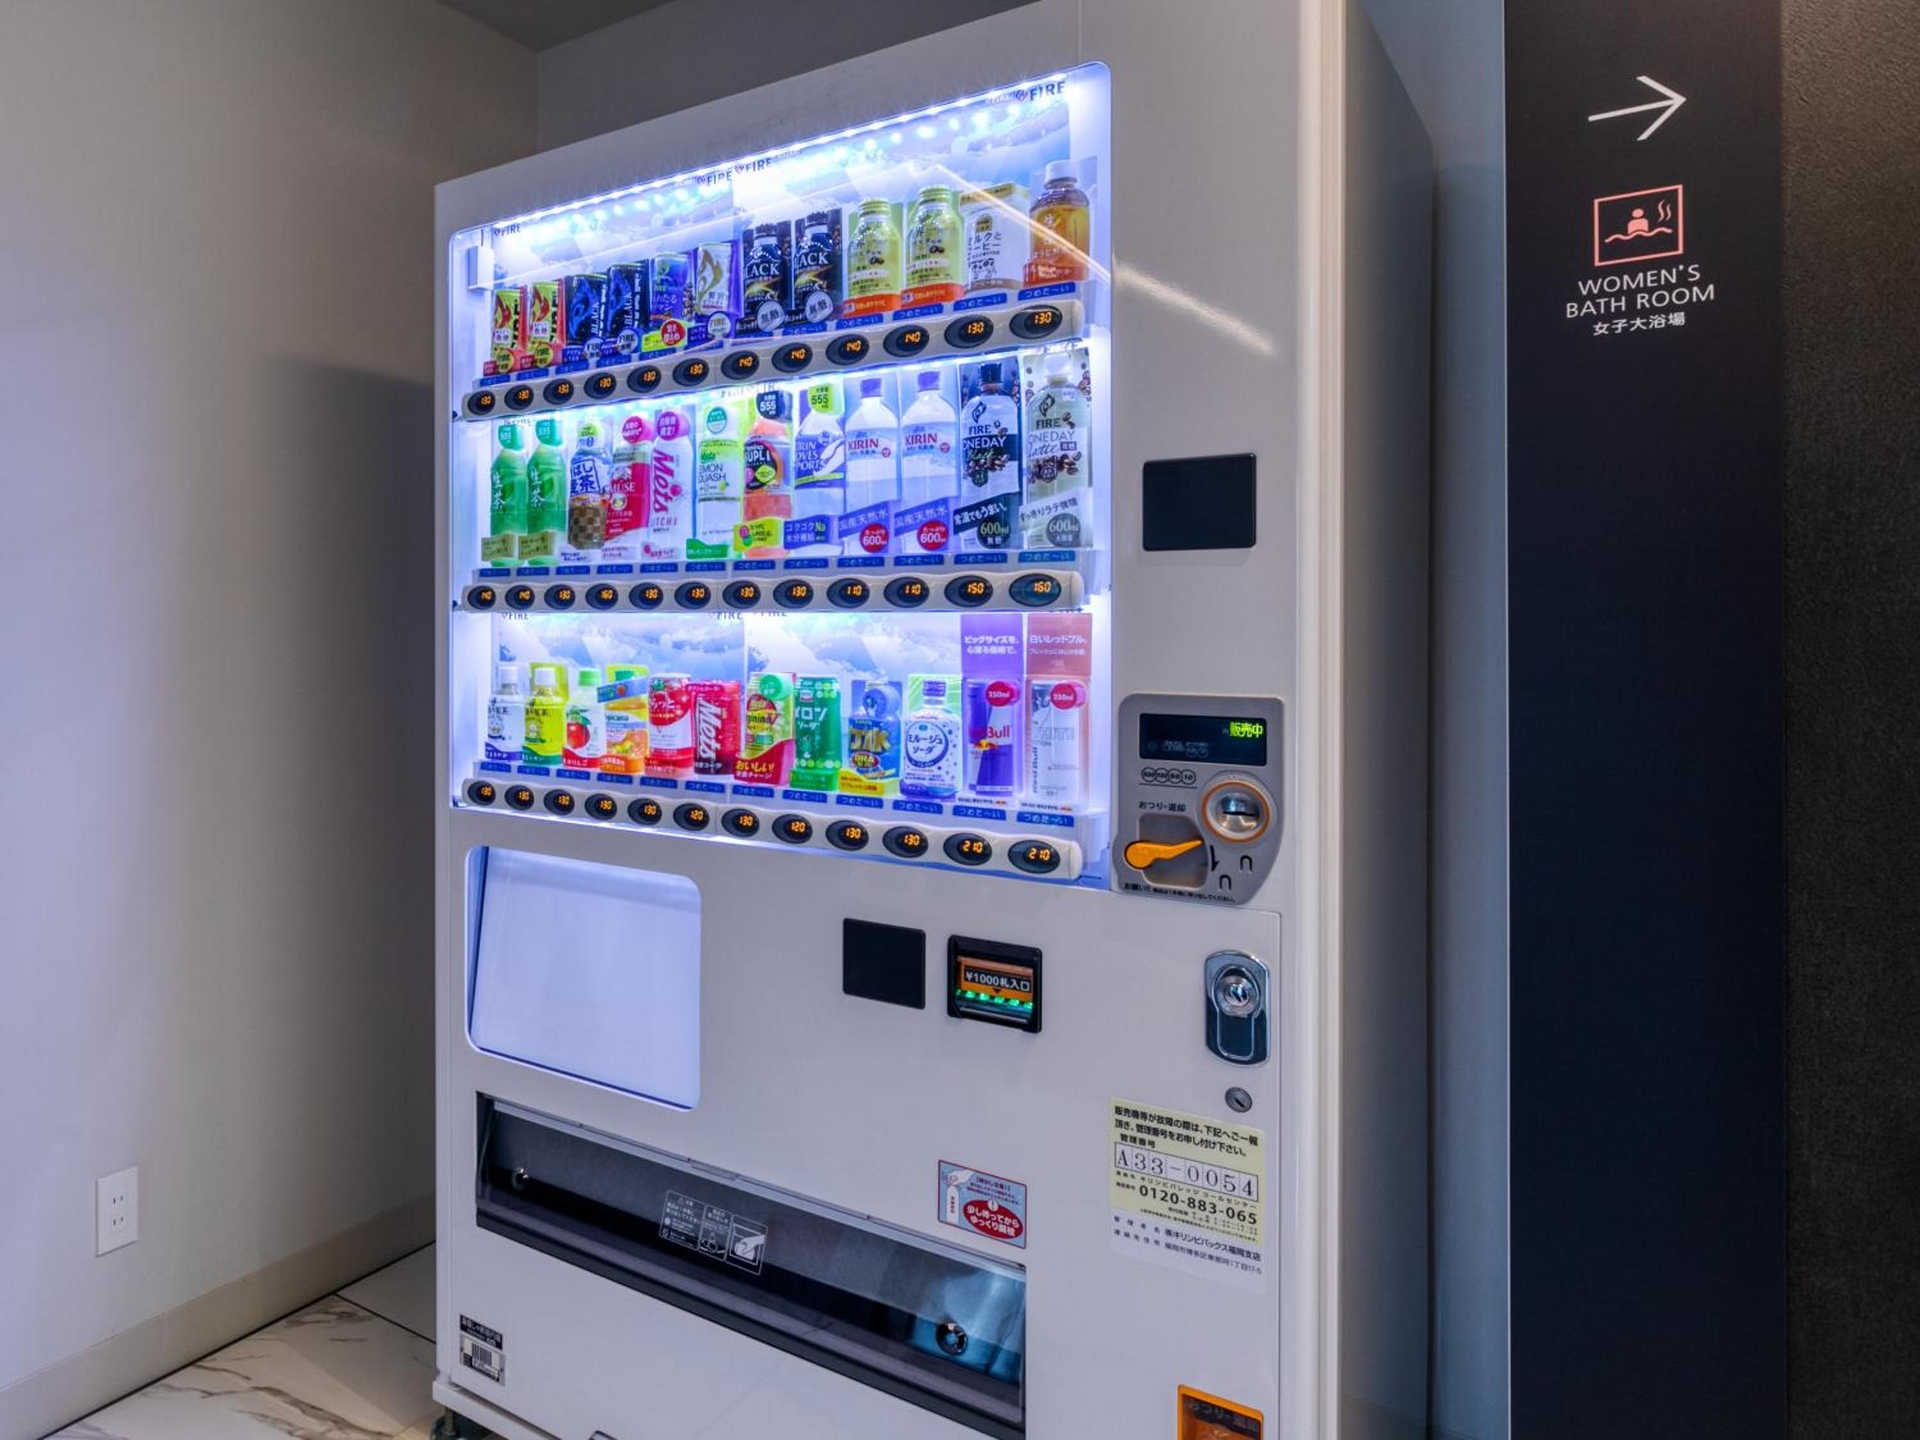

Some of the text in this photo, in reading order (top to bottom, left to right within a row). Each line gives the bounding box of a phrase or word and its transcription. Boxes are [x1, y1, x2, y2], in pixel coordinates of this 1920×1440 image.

[1029, 82, 1066, 101] FIRE
[746, 158, 772, 172] FIRE
[707, 170, 733, 186] FIRE
[1578, 264, 1701, 295] WOMEN'S
[1566, 284, 1715, 318] BATH ROOM
[1034, 310, 1053, 325] 130
[967, 322, 984, 334] 130
[1593, 312, 1686, 336] 女子大浴場
[905, 331, 921, 343] 140
[846, 340, 861, 352] 140
[791, 348, 806, 360] 140
[739, 356, 753, 367] 140
[811, 394, 829, 405] 555
[759, 402, 777, 411] 555
[1036, 417, 1061, 429] FIRE
[969, 425, 992, 435] FIRE
[654, 449, 674, 513] Mets
[740, 586, 754, 598] 130
[792, 585, 807, 597] 130
[847, 585, 862, 596] 110
[905, 583, 922, 595] 110
[967, 582, 985, 595] 150
[1034, 581, 1050, 593] 160
[691, 588, 705, 599] 130
[1229, 721, 1264, 738] 販売中
[690, 809, 704, 821] 120
[739, 815, 754, 827] 130
[791, 821, 806, 833] 120
[845, 827, 862, 839] 130
[904, 833, 921, 846] 130
[962, 840, 984, 854] 210
[1028, 848, 1051, 861] 210
[1117, 1149, 1253, 1197] A33-0054
[1139, 1185, 1257, 1225] 0120-883-065
